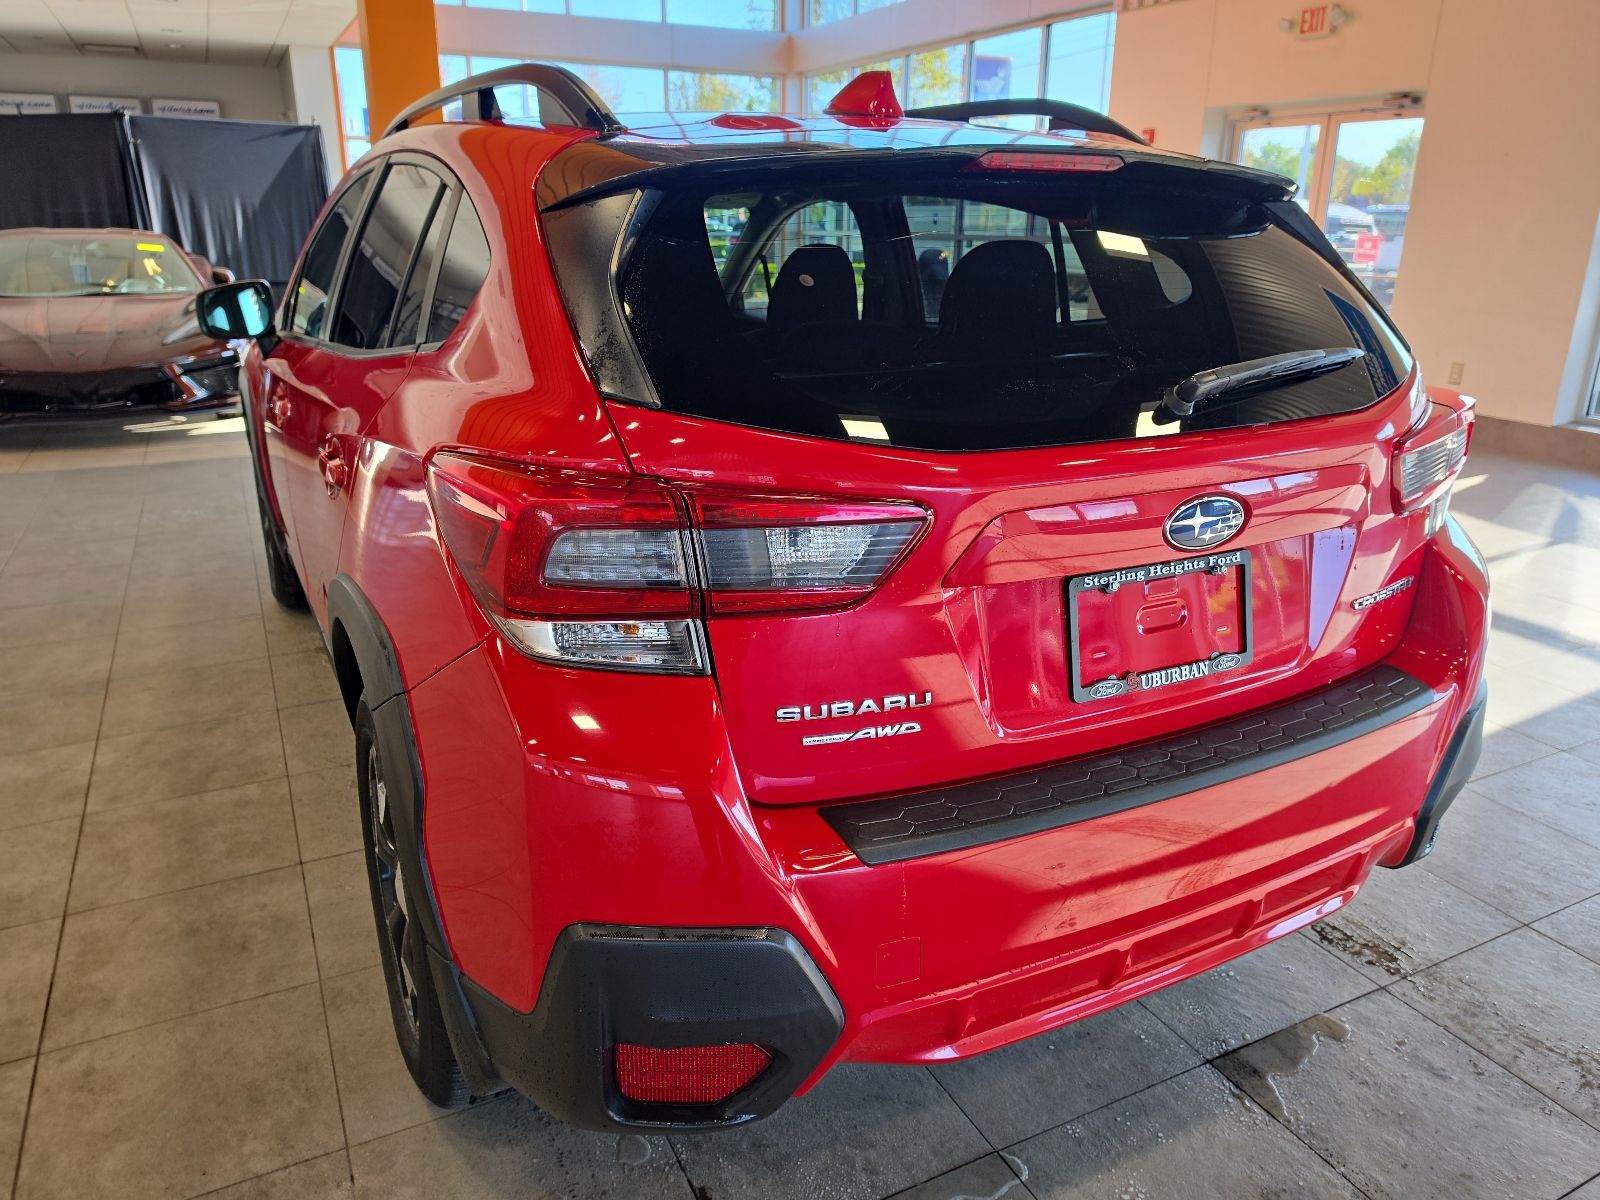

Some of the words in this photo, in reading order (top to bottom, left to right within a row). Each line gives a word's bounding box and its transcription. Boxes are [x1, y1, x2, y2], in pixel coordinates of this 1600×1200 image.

[1300, 6, 1328, 35] EXIT
[1083, 568, 1145, 588] Sterling
[1149, 560, 1205, 577] Heights
[1208, 552, 1241, 567] Ford
[1127, 660, 1210, 692] SUBURBAN
[776, 691, 932, 723] SUBARU
[850, 721, 922, 741] AWD
